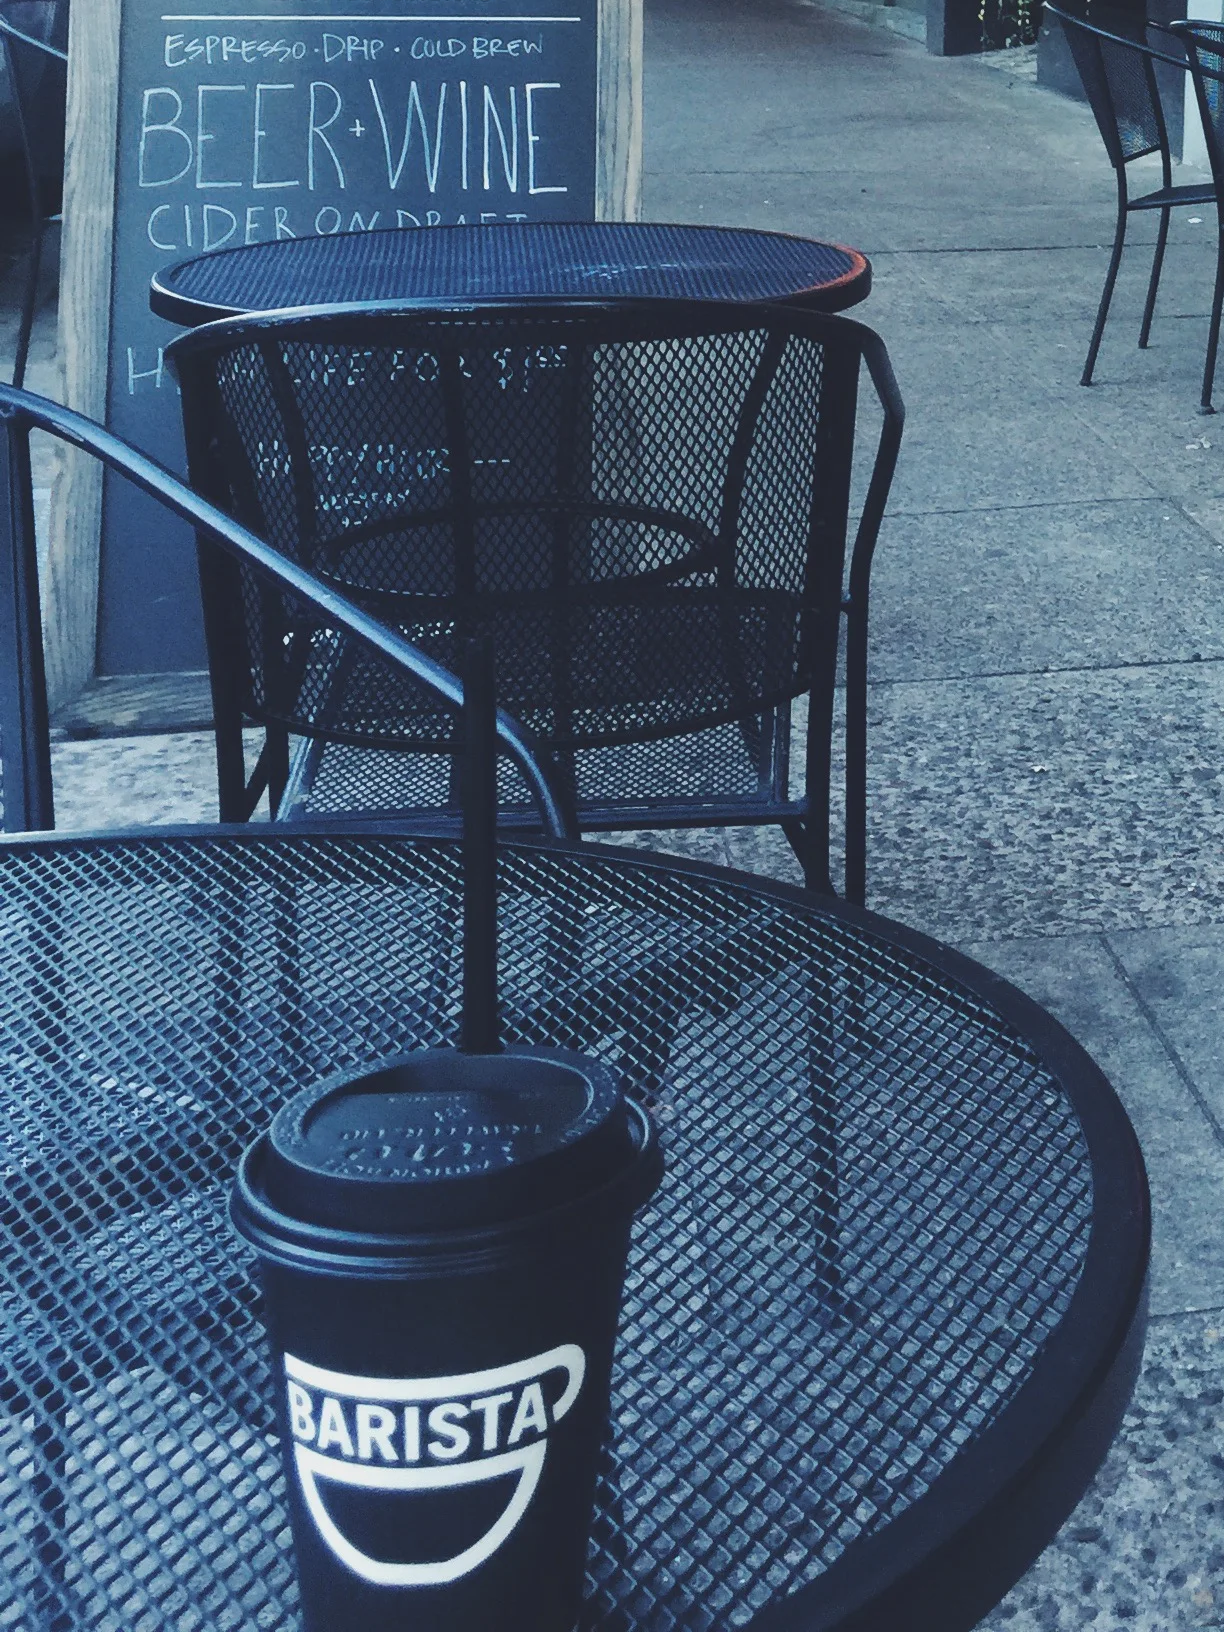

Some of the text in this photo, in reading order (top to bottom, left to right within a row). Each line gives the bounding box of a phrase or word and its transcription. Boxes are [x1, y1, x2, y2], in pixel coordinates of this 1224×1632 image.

[164, 33, 543, 67] ESPRESSO DRIP COLD BREW
[138, 80, 346, 191] BEER
[368, 78, 569, 195] WINE
[147, 204, 298, 252] CIDER
[315, 206, 380, 236] ON
[287, 1379, 548, 1463] BARISTA
